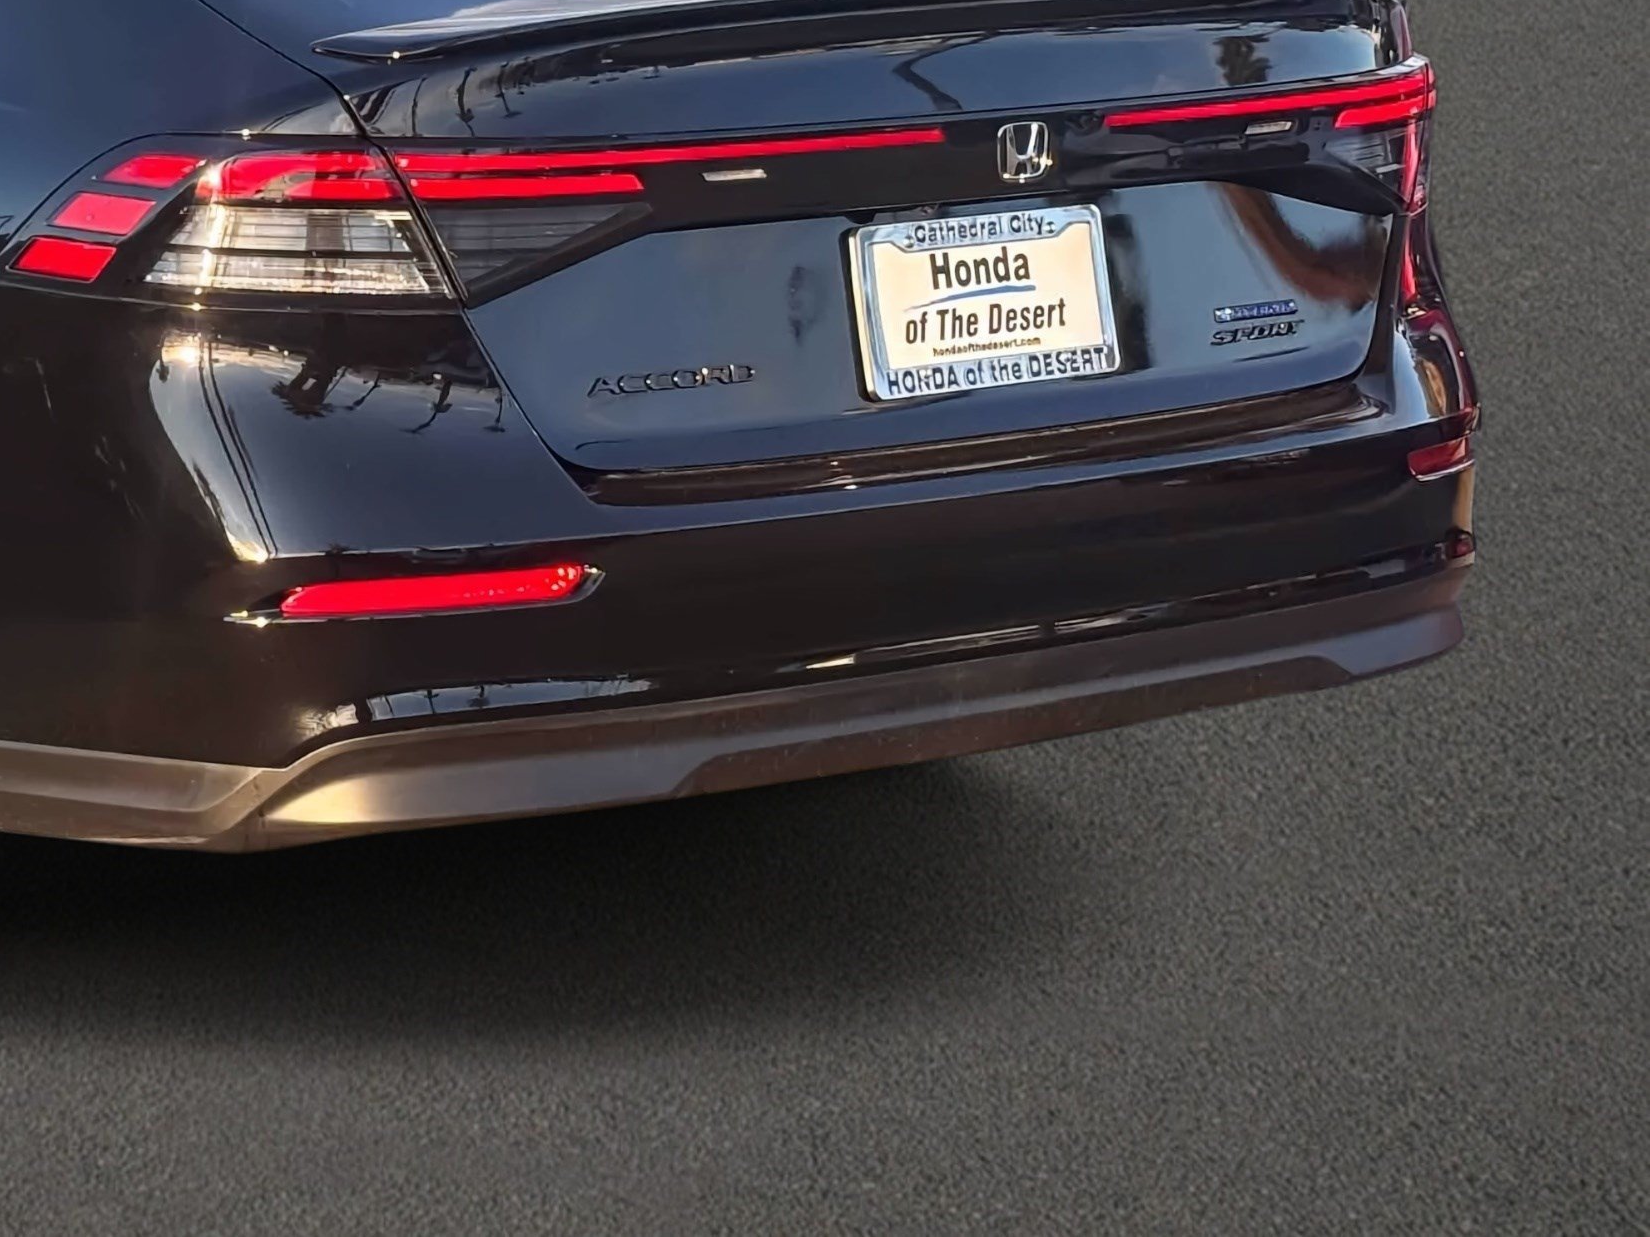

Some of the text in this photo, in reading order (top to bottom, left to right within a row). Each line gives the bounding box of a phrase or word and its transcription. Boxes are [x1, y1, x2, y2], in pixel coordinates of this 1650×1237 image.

[913, 213, 1044, 244] Cathedral City
[929, 246, 1031, 290] Honda
[905, 298, 1067, 344] of The Desert
[1211, 319, 1306, 346] SPORT
[587, 364, 756, 398] ACCORD
[887, 346, 1108, 396] HONDA of the DESERT
